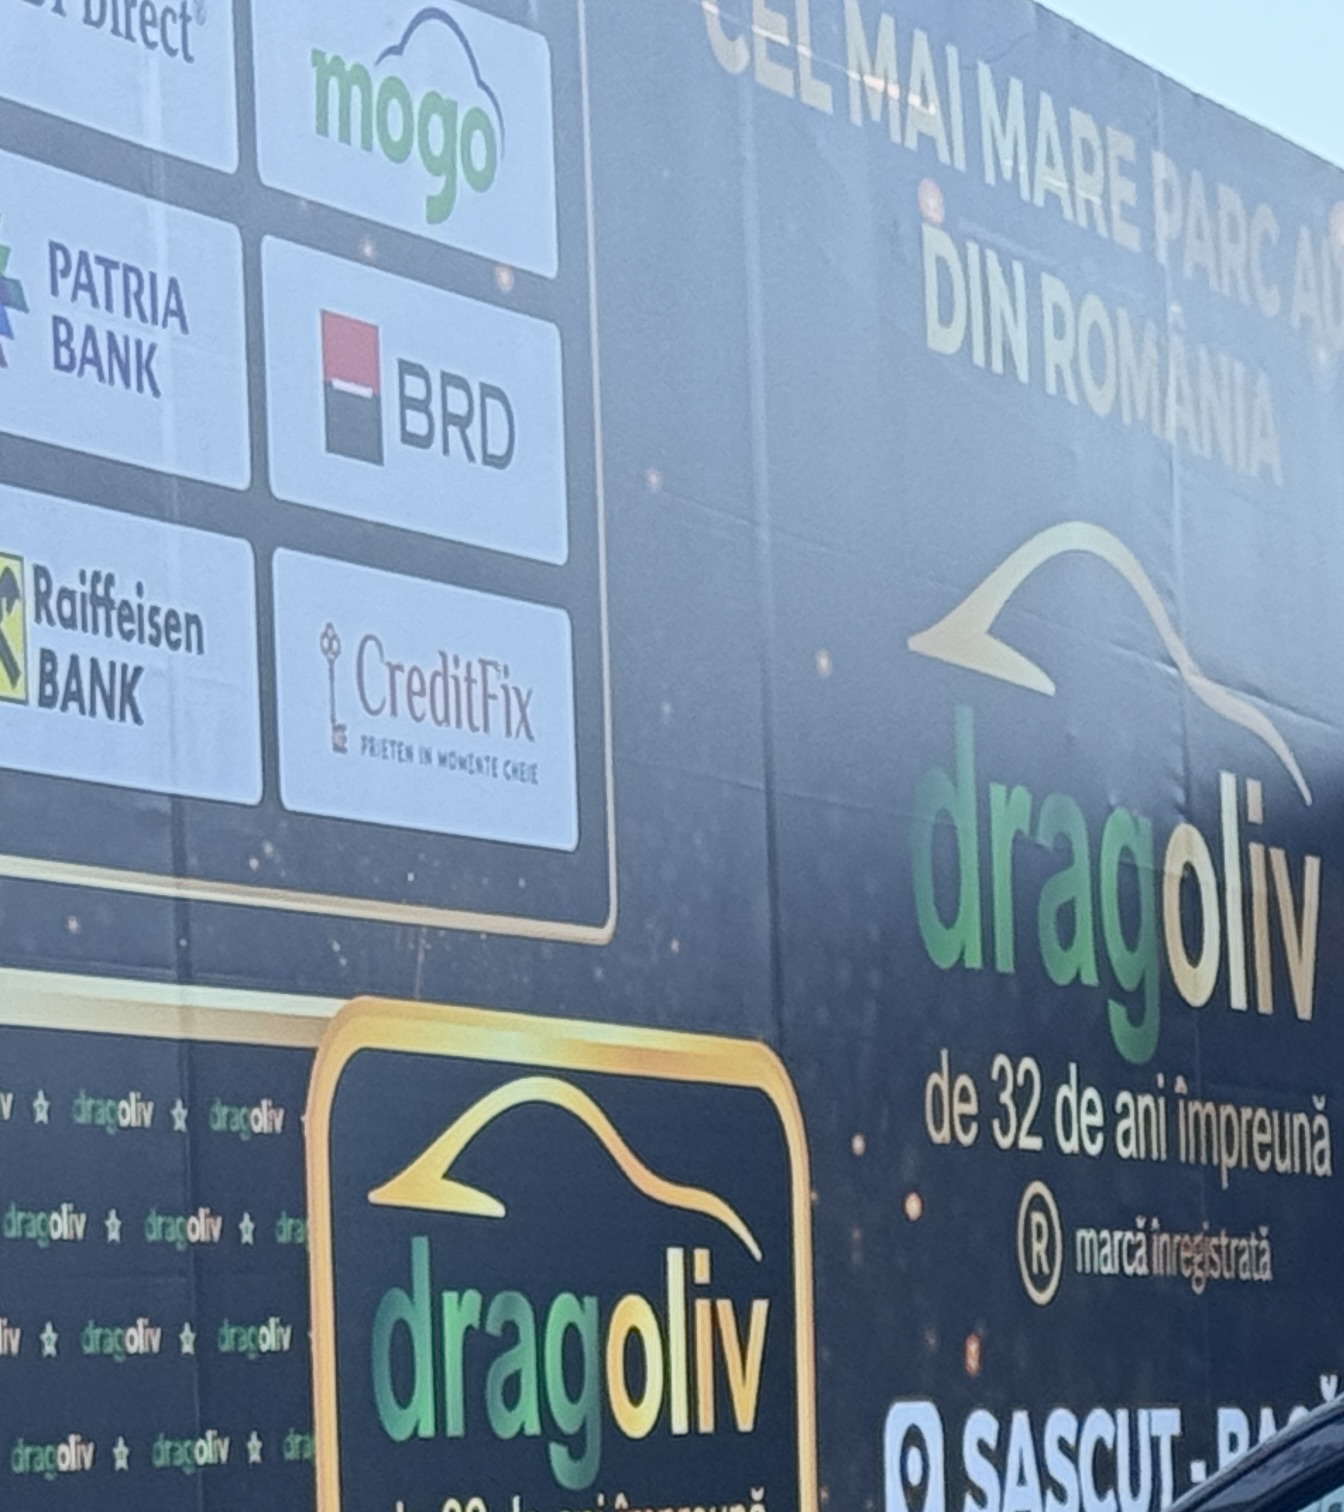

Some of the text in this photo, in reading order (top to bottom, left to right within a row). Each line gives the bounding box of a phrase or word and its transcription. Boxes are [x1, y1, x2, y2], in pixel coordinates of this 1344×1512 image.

[311, 48, 499, 224] mogo
[844, 0, 966, 174] MAI
[977, 58, 1141, 252] MARE
[1151, 150, 1280, 318] PARC
[48, 240, 189, 335] PATRIA
[52, 316, 161, 398] BANK
[920, 222, 1284, 487] DIN ROMÂNIA
[397, 357, 516, 470] BRD
[32, 564, 205, 655] Raiffeisen
[38, 648, 145, 725] BANK
[355, 633, 536, 741] CreditFix
[910, 705, 1321, 1064] dragoliv
[72, 1090, 283, 1141] dragoliv dragoliv
[925, 1048, 1333, 1190] de 32 de ani împreună
[3, 1203, 86, 1248] dragoliv
[145, 1207, 222, 1251] dragoliv
[1075, 1216, 1148, 1276] marcă
[1152, 1216, 1272, 1294] înregistrată
[82, 1317, 291, 1362] dragoliv dragoliv
[371, 1236, 769, 1490] dragoliv
[11, 1434, 94, 1480] dragoliv
[152, 1429, 229, 1475] dragoliv
